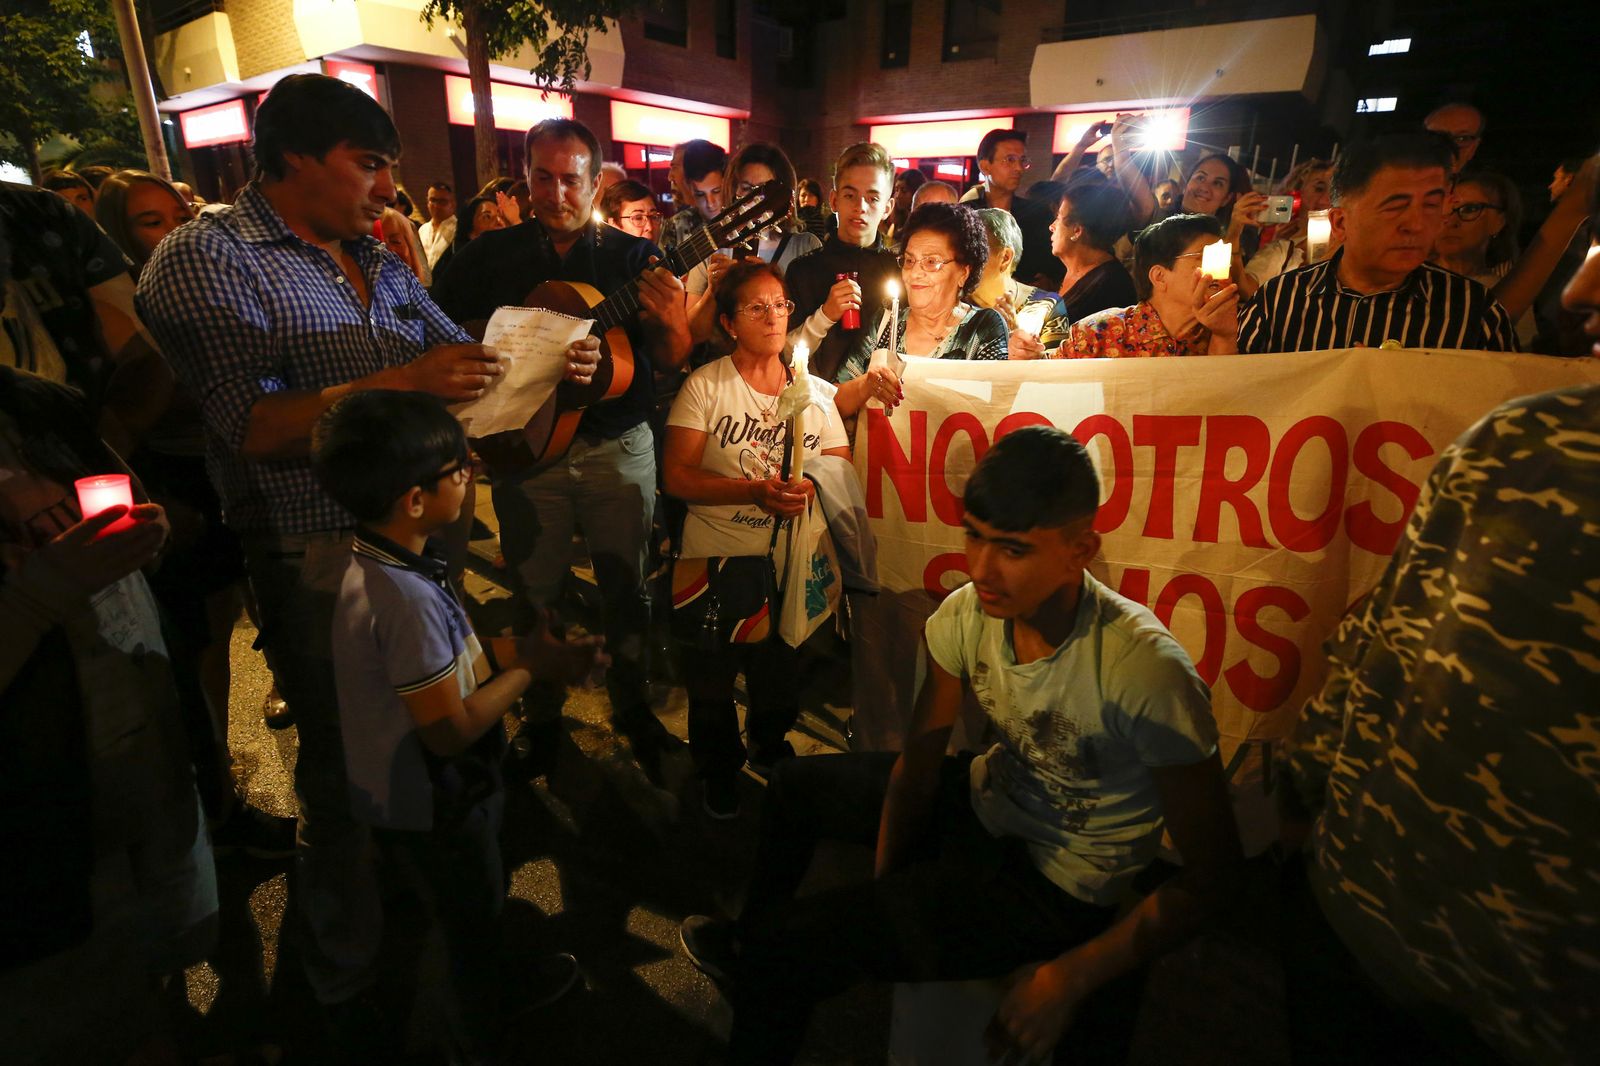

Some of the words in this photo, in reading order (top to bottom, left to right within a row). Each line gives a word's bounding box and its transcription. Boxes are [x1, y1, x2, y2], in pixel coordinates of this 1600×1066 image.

[713, 412, 820, 451] Whater
[865, 408, 1435, 556] NOOTROS
[730, 510, 772, 529] break
